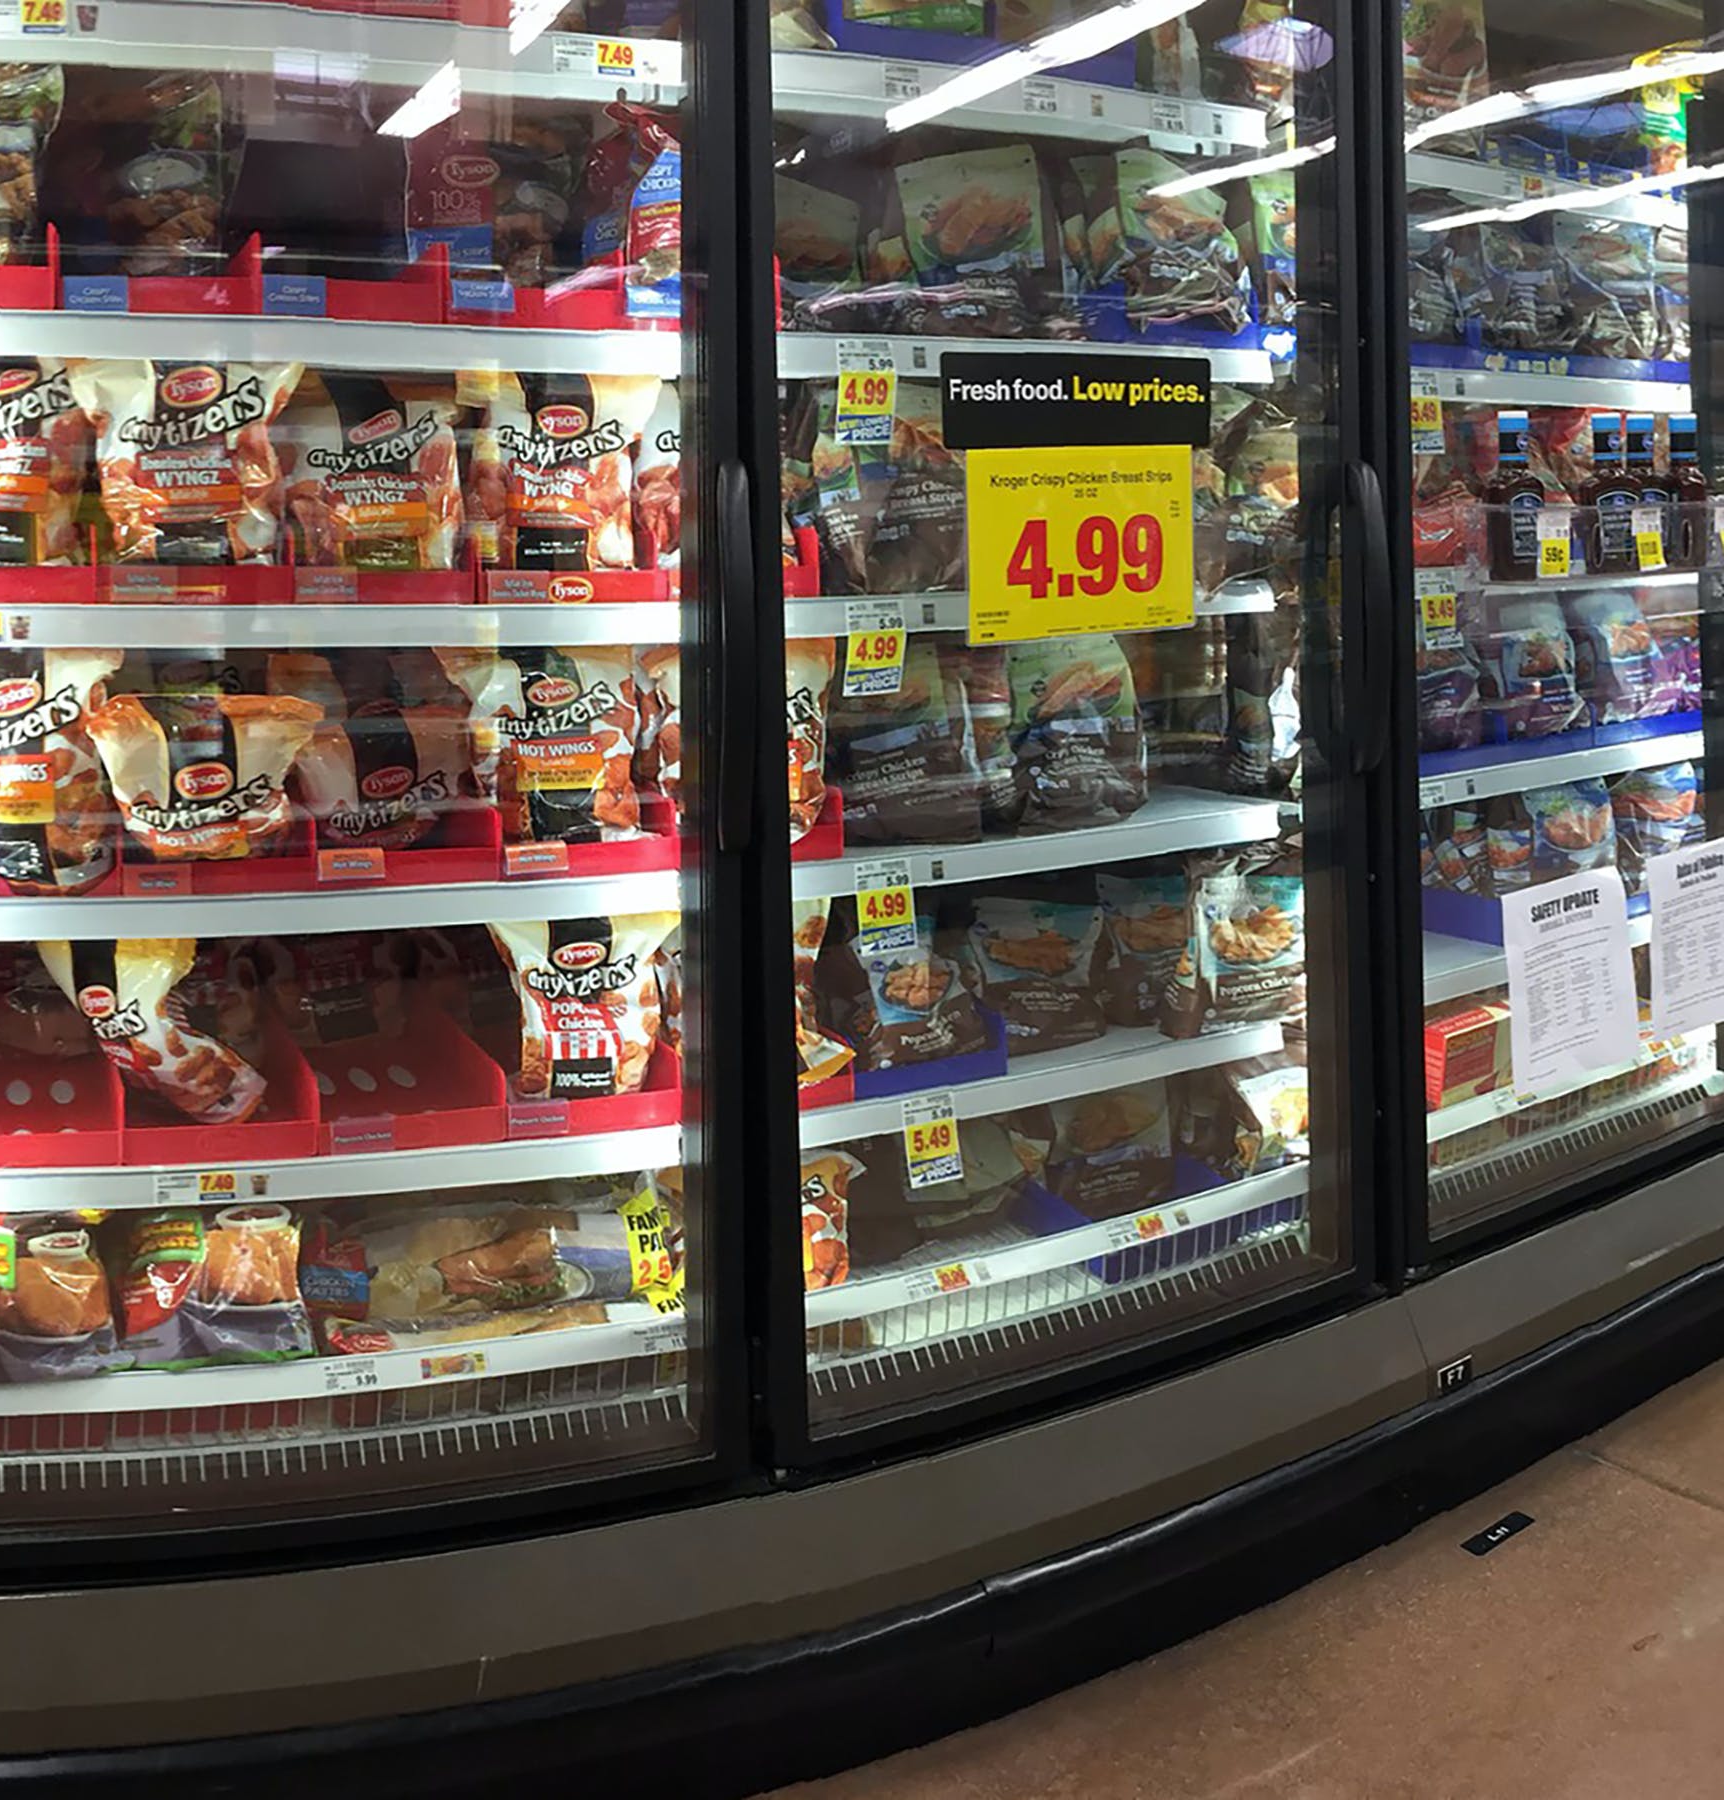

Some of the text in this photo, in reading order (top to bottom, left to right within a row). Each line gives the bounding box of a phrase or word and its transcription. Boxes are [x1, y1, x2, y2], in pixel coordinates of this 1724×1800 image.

[24, 1, 62, 23] 7.49
[598, 43, 634, 65] 7.49
[451, 162, 496, 180] Tyson
[430, 190, 481, 212] 100%
[869, 358, 894, 371] 5.99
[170, 376, 216, 399] Tyson
[844, 378, 888, 405] 4.99
[949, 376, 1205, 407] Fresh food. Low prices.
[852, 423, 891, 441] PRICE
[156, 470, 221, 486] WYNGZ
[989, 471, 1173, 491] Kroger Crispy Chicken Breast Strips
[345, 490, 407, 504] WYNGZ
[1006, 513, 1163, 599] 4.99
[553, 583, 588, 599] Tyson
[1427, 594, 1454, 613] 5.49
[879, 617, 903, 630] 5.99
[855, 636, 898, 661] 4.99
[536, 683, 573, 699] Tyson
[859, 677, 900, 693] PRICE
[518, 739, 596, 757] HOT WINGS
[370, 772, 409, 791] Tyson
[886, 874, 910, 886] 5.99
[866, 893, 906, 918] 4.99
[1531, 888, 1599, 922] SAFETY UPDATE
[875, 933, 915, 950] PRICE
[560, 947, 600, 963] Tyson
[558, 1016, 607, 1031] Chicken
[913, 1130, 950, 1151] 5.49
[201, 1176, 234, 1192] 7.49
[1447, 1365, 1464, 1386] F7
